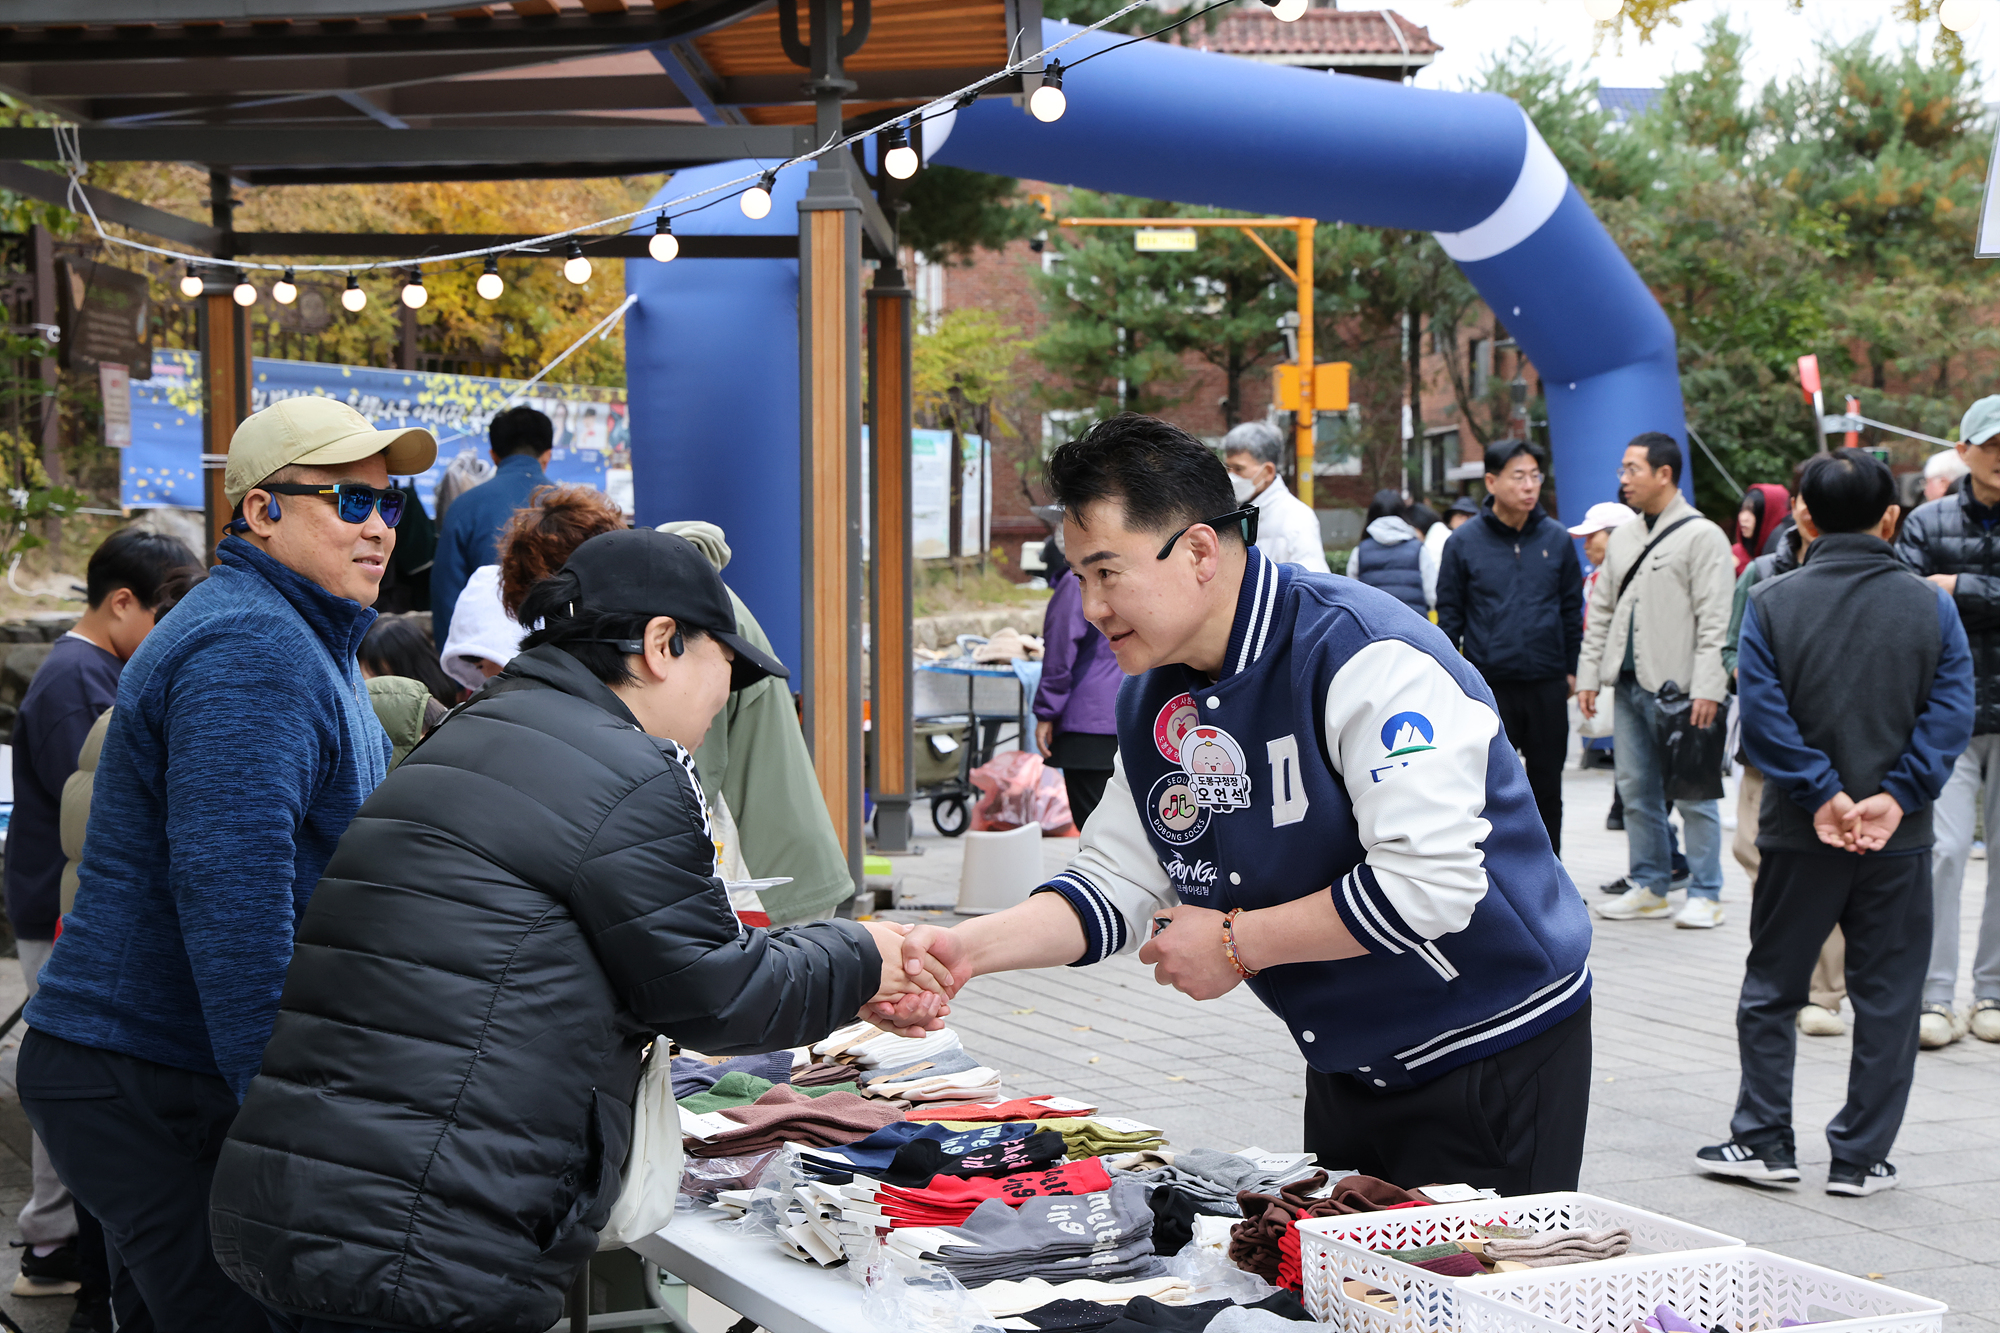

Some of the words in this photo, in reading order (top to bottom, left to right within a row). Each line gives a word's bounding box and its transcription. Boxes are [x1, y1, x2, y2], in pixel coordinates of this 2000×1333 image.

[1166, 776, 1189, 787] SEOU
[1198, 776, 1238, 787] 도봉구청장
[1266, 733, 1310, 829] D
[1153, 818, 1183, 841] DOBONG
[1184, 818, 1206, 840] SOCKS
[1046, 1204, 1086, 1235] ing
[1086, 1193, 1122, 1243] melt
